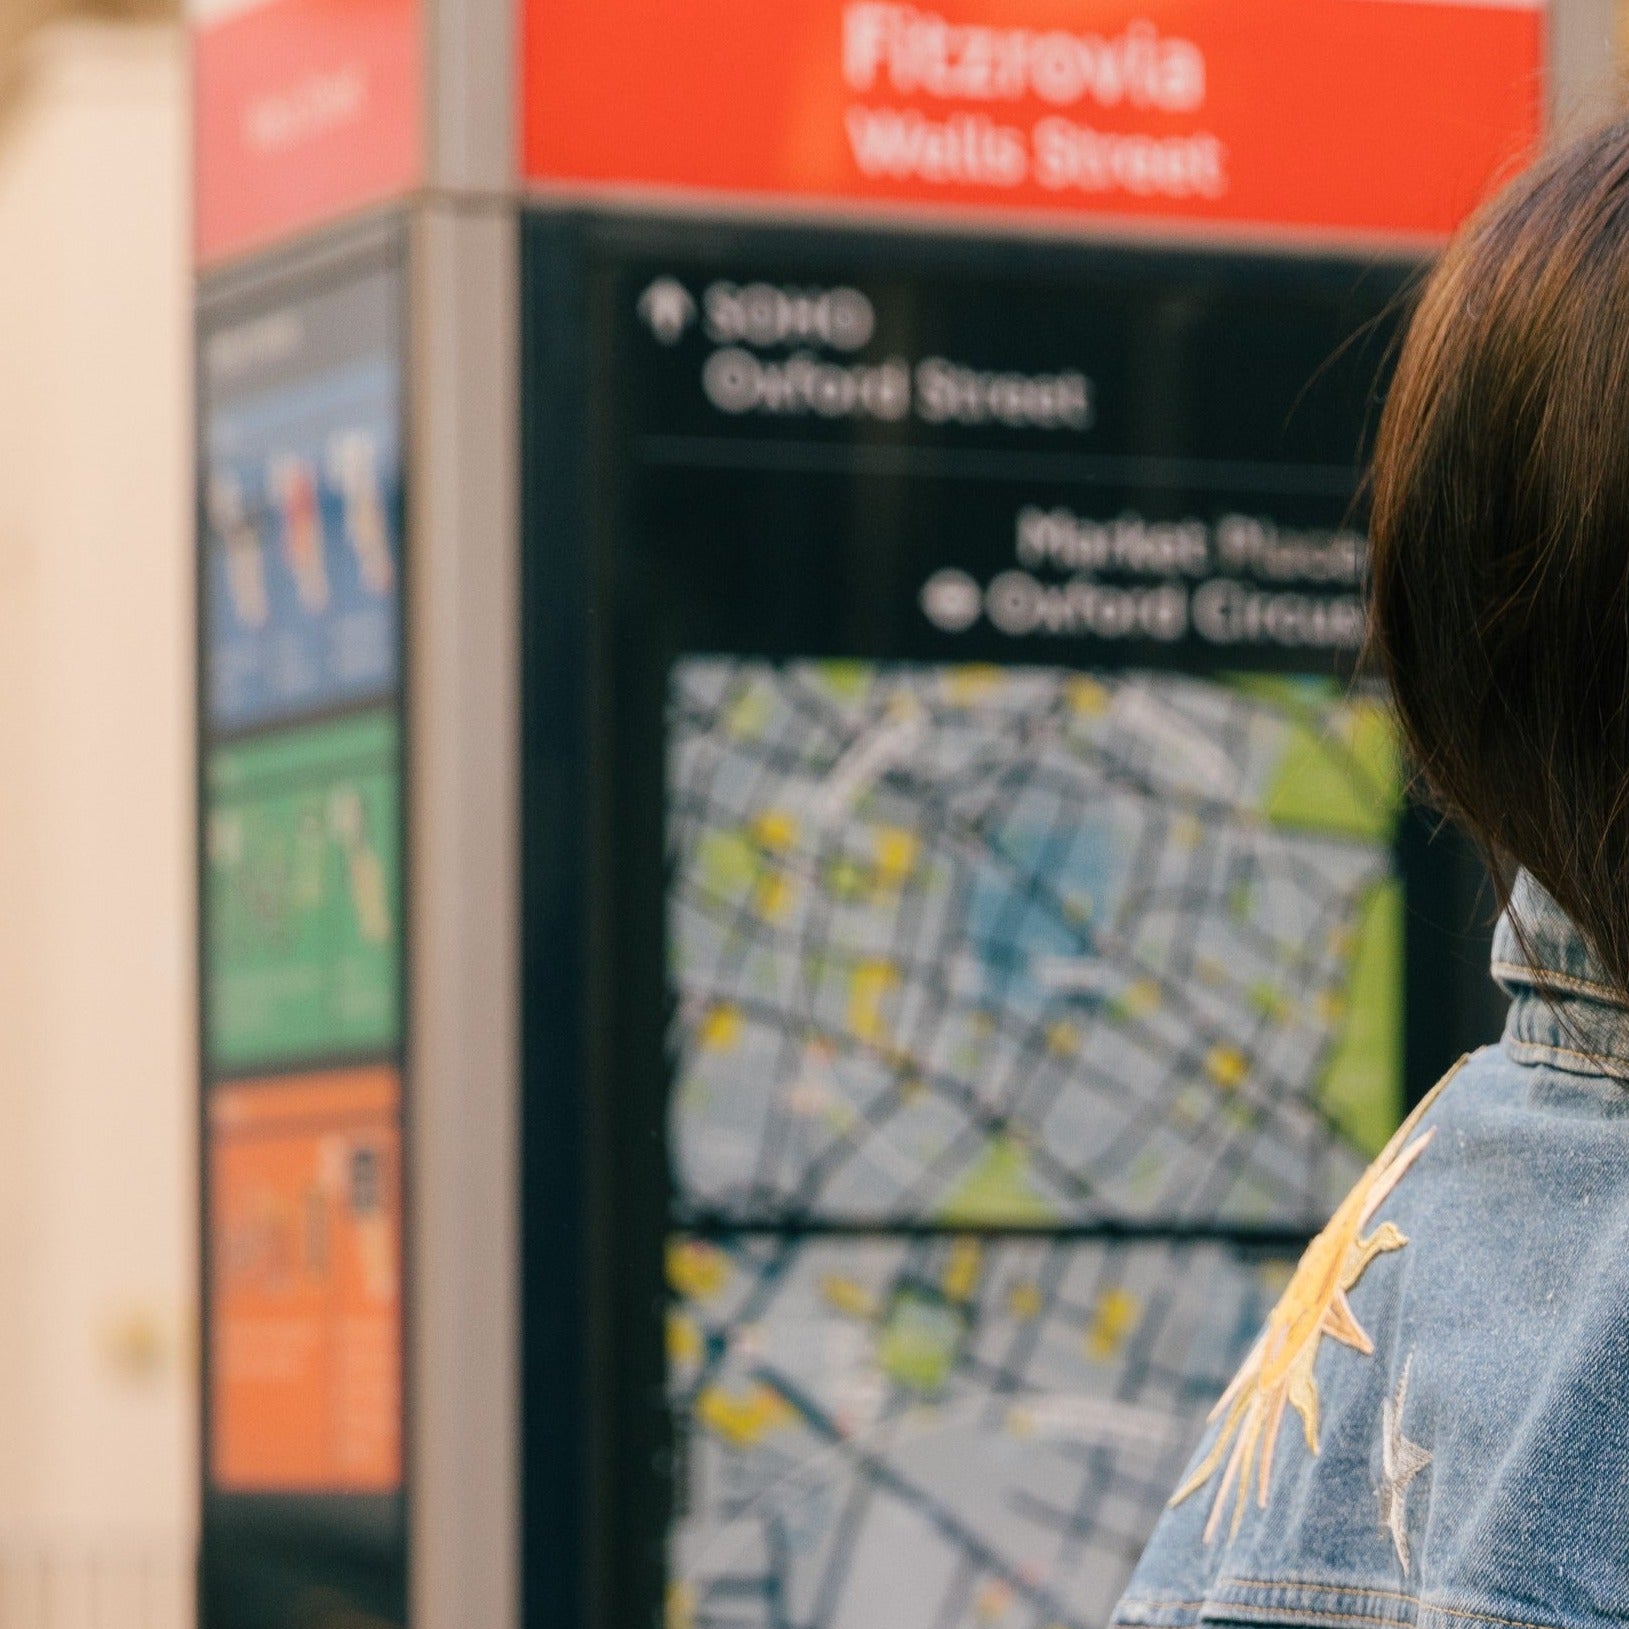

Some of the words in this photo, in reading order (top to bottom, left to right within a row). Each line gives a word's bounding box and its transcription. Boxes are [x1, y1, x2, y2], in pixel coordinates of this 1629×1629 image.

[842, 0, 1206, 112] Fitzrovia
[844, 106, 1028, 188] Wells
[1032, 116, 1228, 198] Street
[704, 347, 911, 420] Oxford
[914, 356, 1096, 432] Street
[1016, 506, 1207, 578] Market
[986, 570, 1187, 642] Oxford
[1192, 578, 1368, 648] Circu
